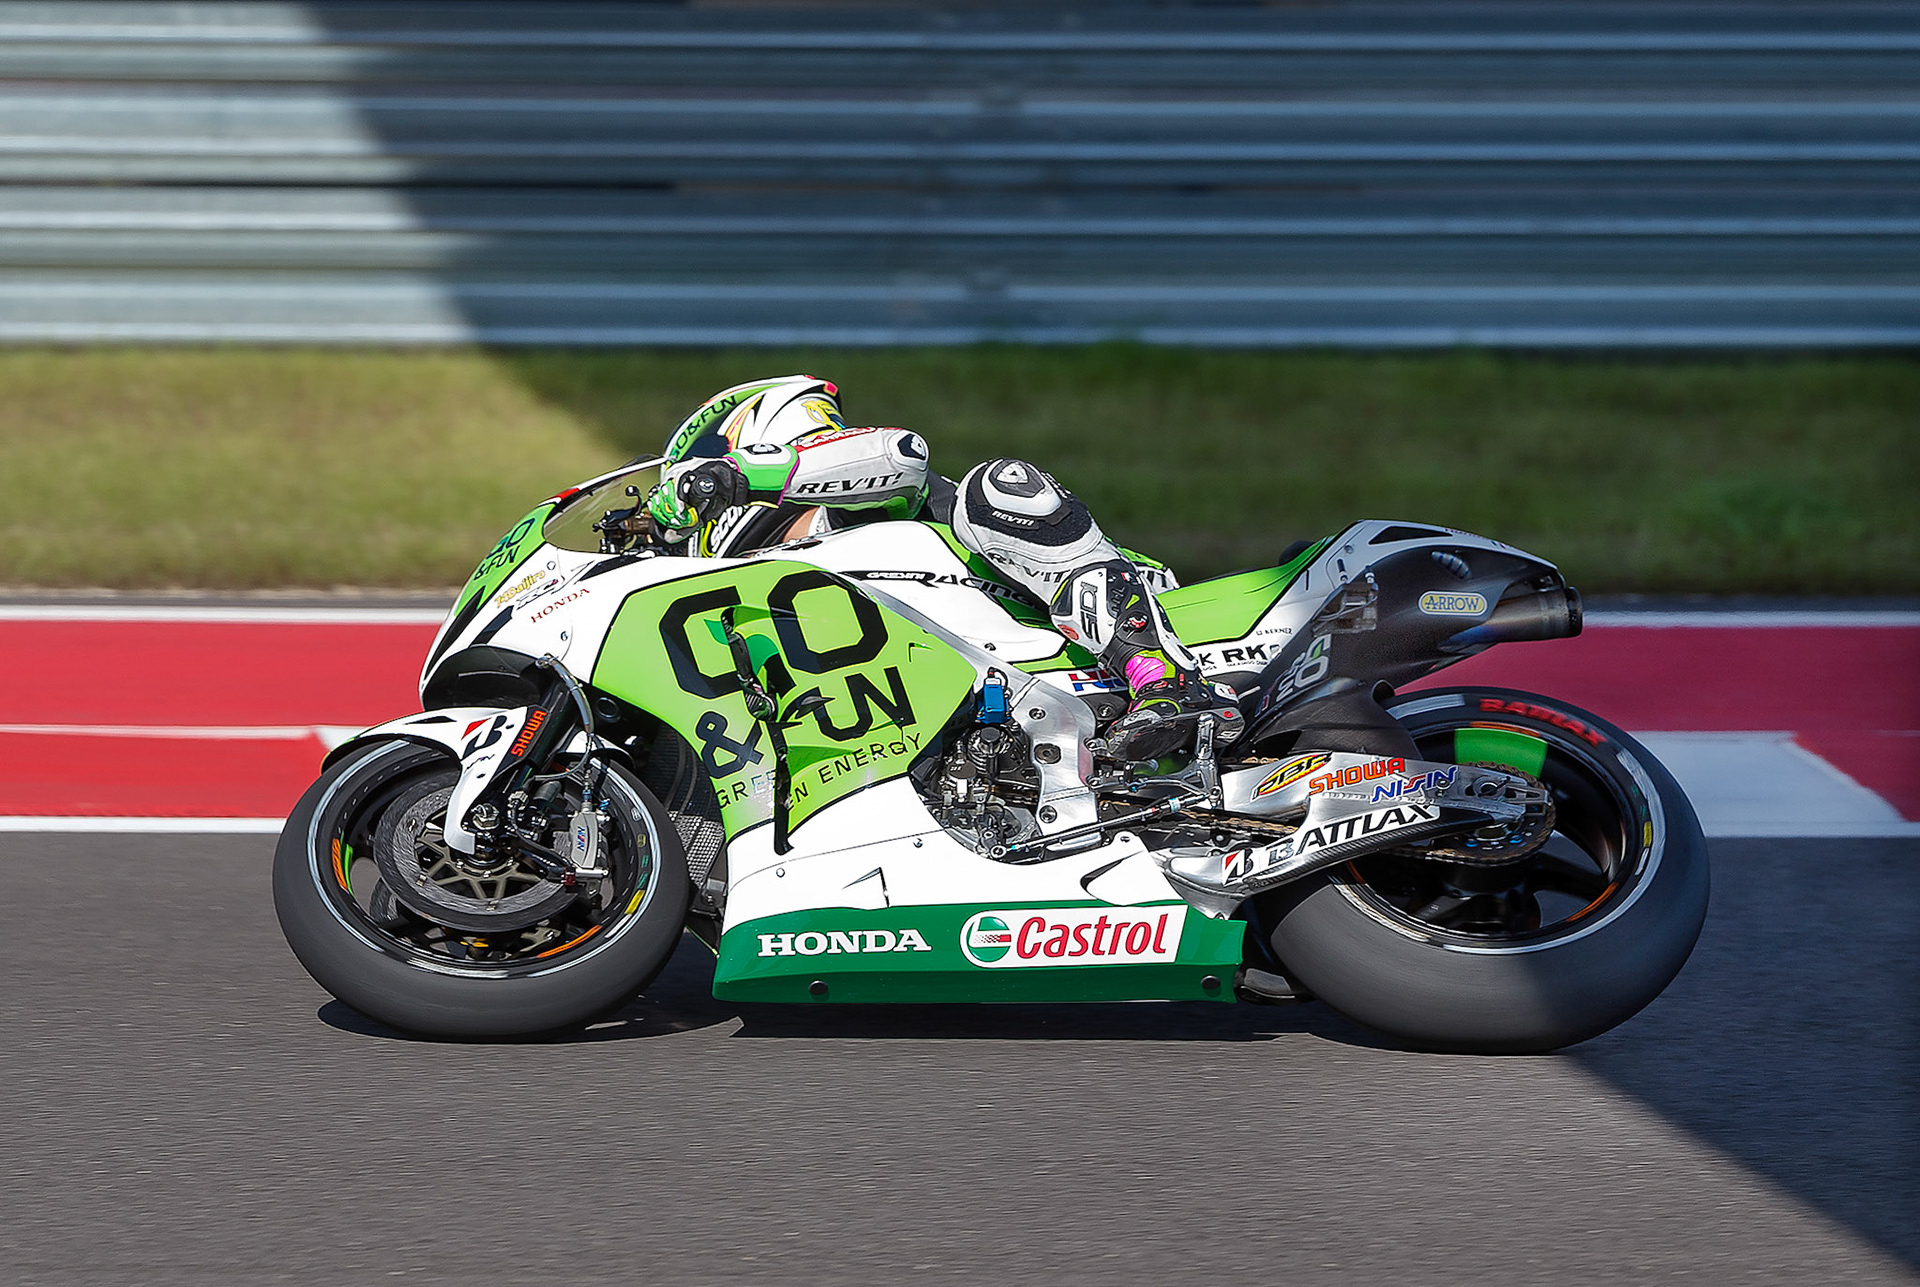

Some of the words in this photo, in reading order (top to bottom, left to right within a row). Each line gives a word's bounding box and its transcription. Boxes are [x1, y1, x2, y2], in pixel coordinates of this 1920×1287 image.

[796, 472, 904, 494] REV'IT!
[530, 588, 590, 624] HONDA
[1424, 596, 1480, 611] ARROW
[510, 709, 548, 758] SHOWA
[818, 732, 922, 784] ENERGY
[1308, 756, 1406, 796] SHOWA
[1267, 804, 1436, 866] BATTLAX
[757, 928, 933, 957] HONDA
[1016, 913, 1169, 960] Castrol
